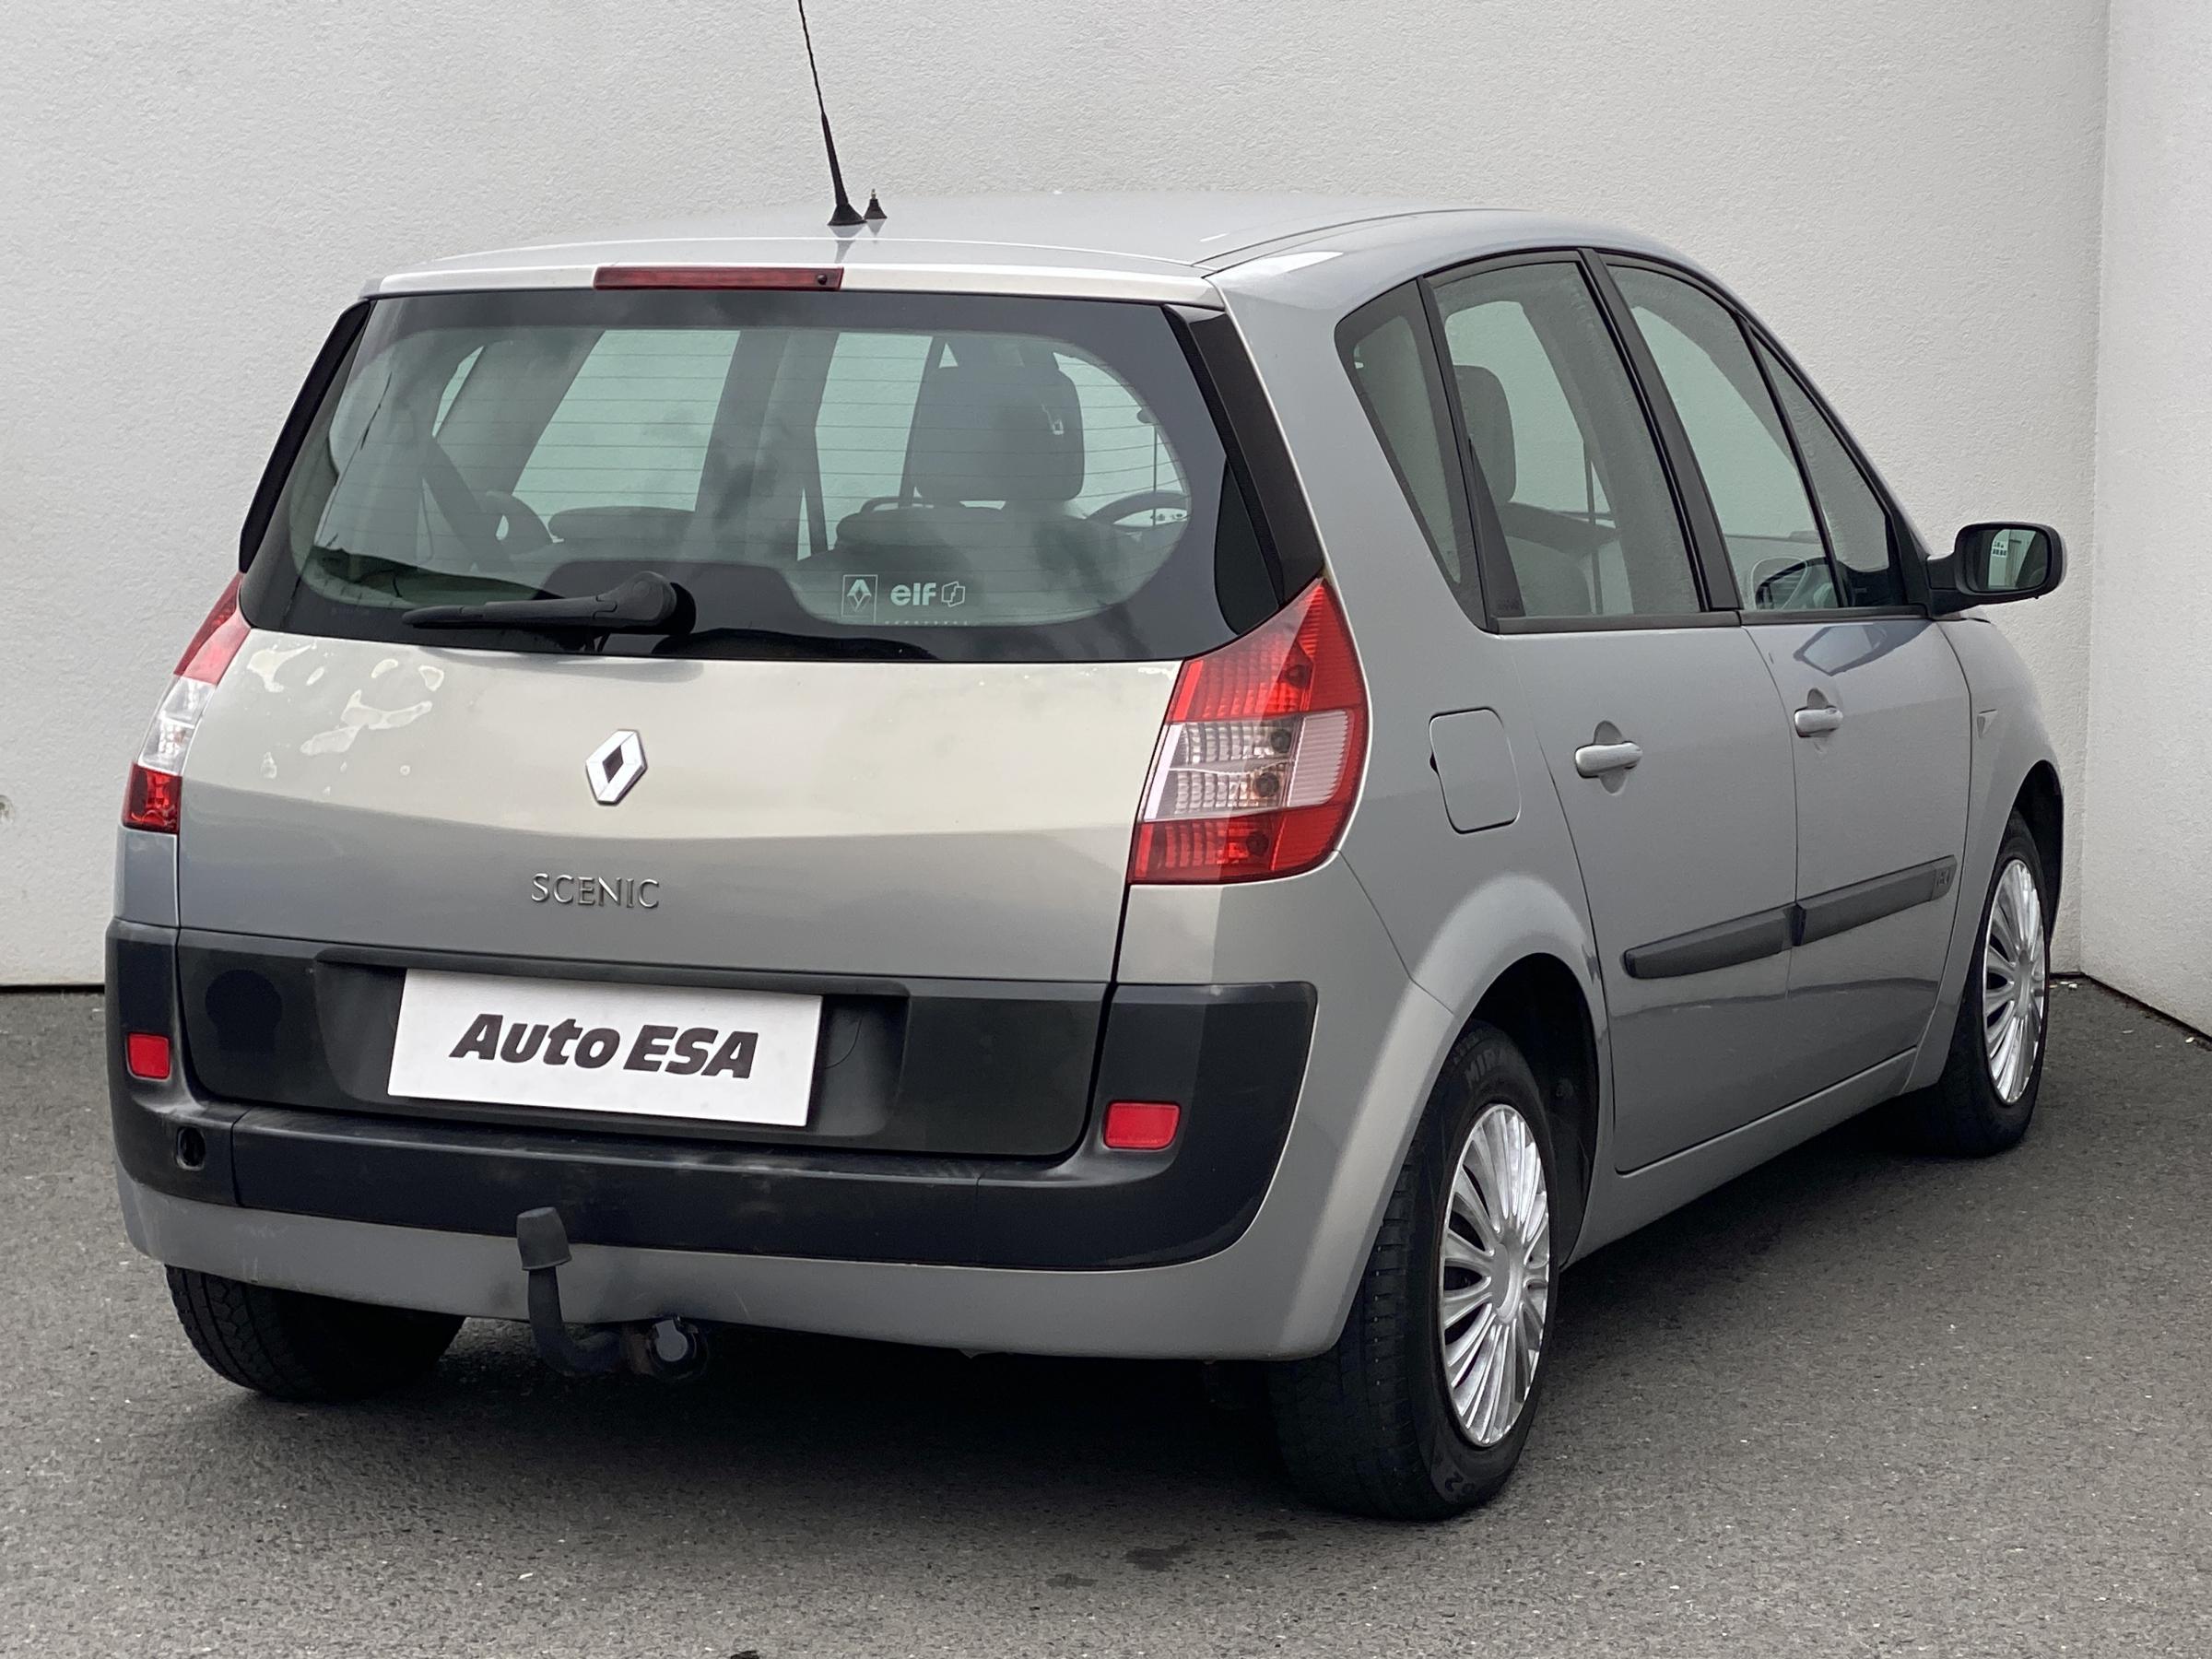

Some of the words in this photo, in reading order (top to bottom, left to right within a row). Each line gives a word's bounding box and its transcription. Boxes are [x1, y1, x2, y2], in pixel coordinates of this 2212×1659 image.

[890, 582, 936, 606] elf
[531, 873, 660, 909] SCENIC
[448, 1013, 620, 1068] Auto
[623, 1024, 759, 1078] ESA
